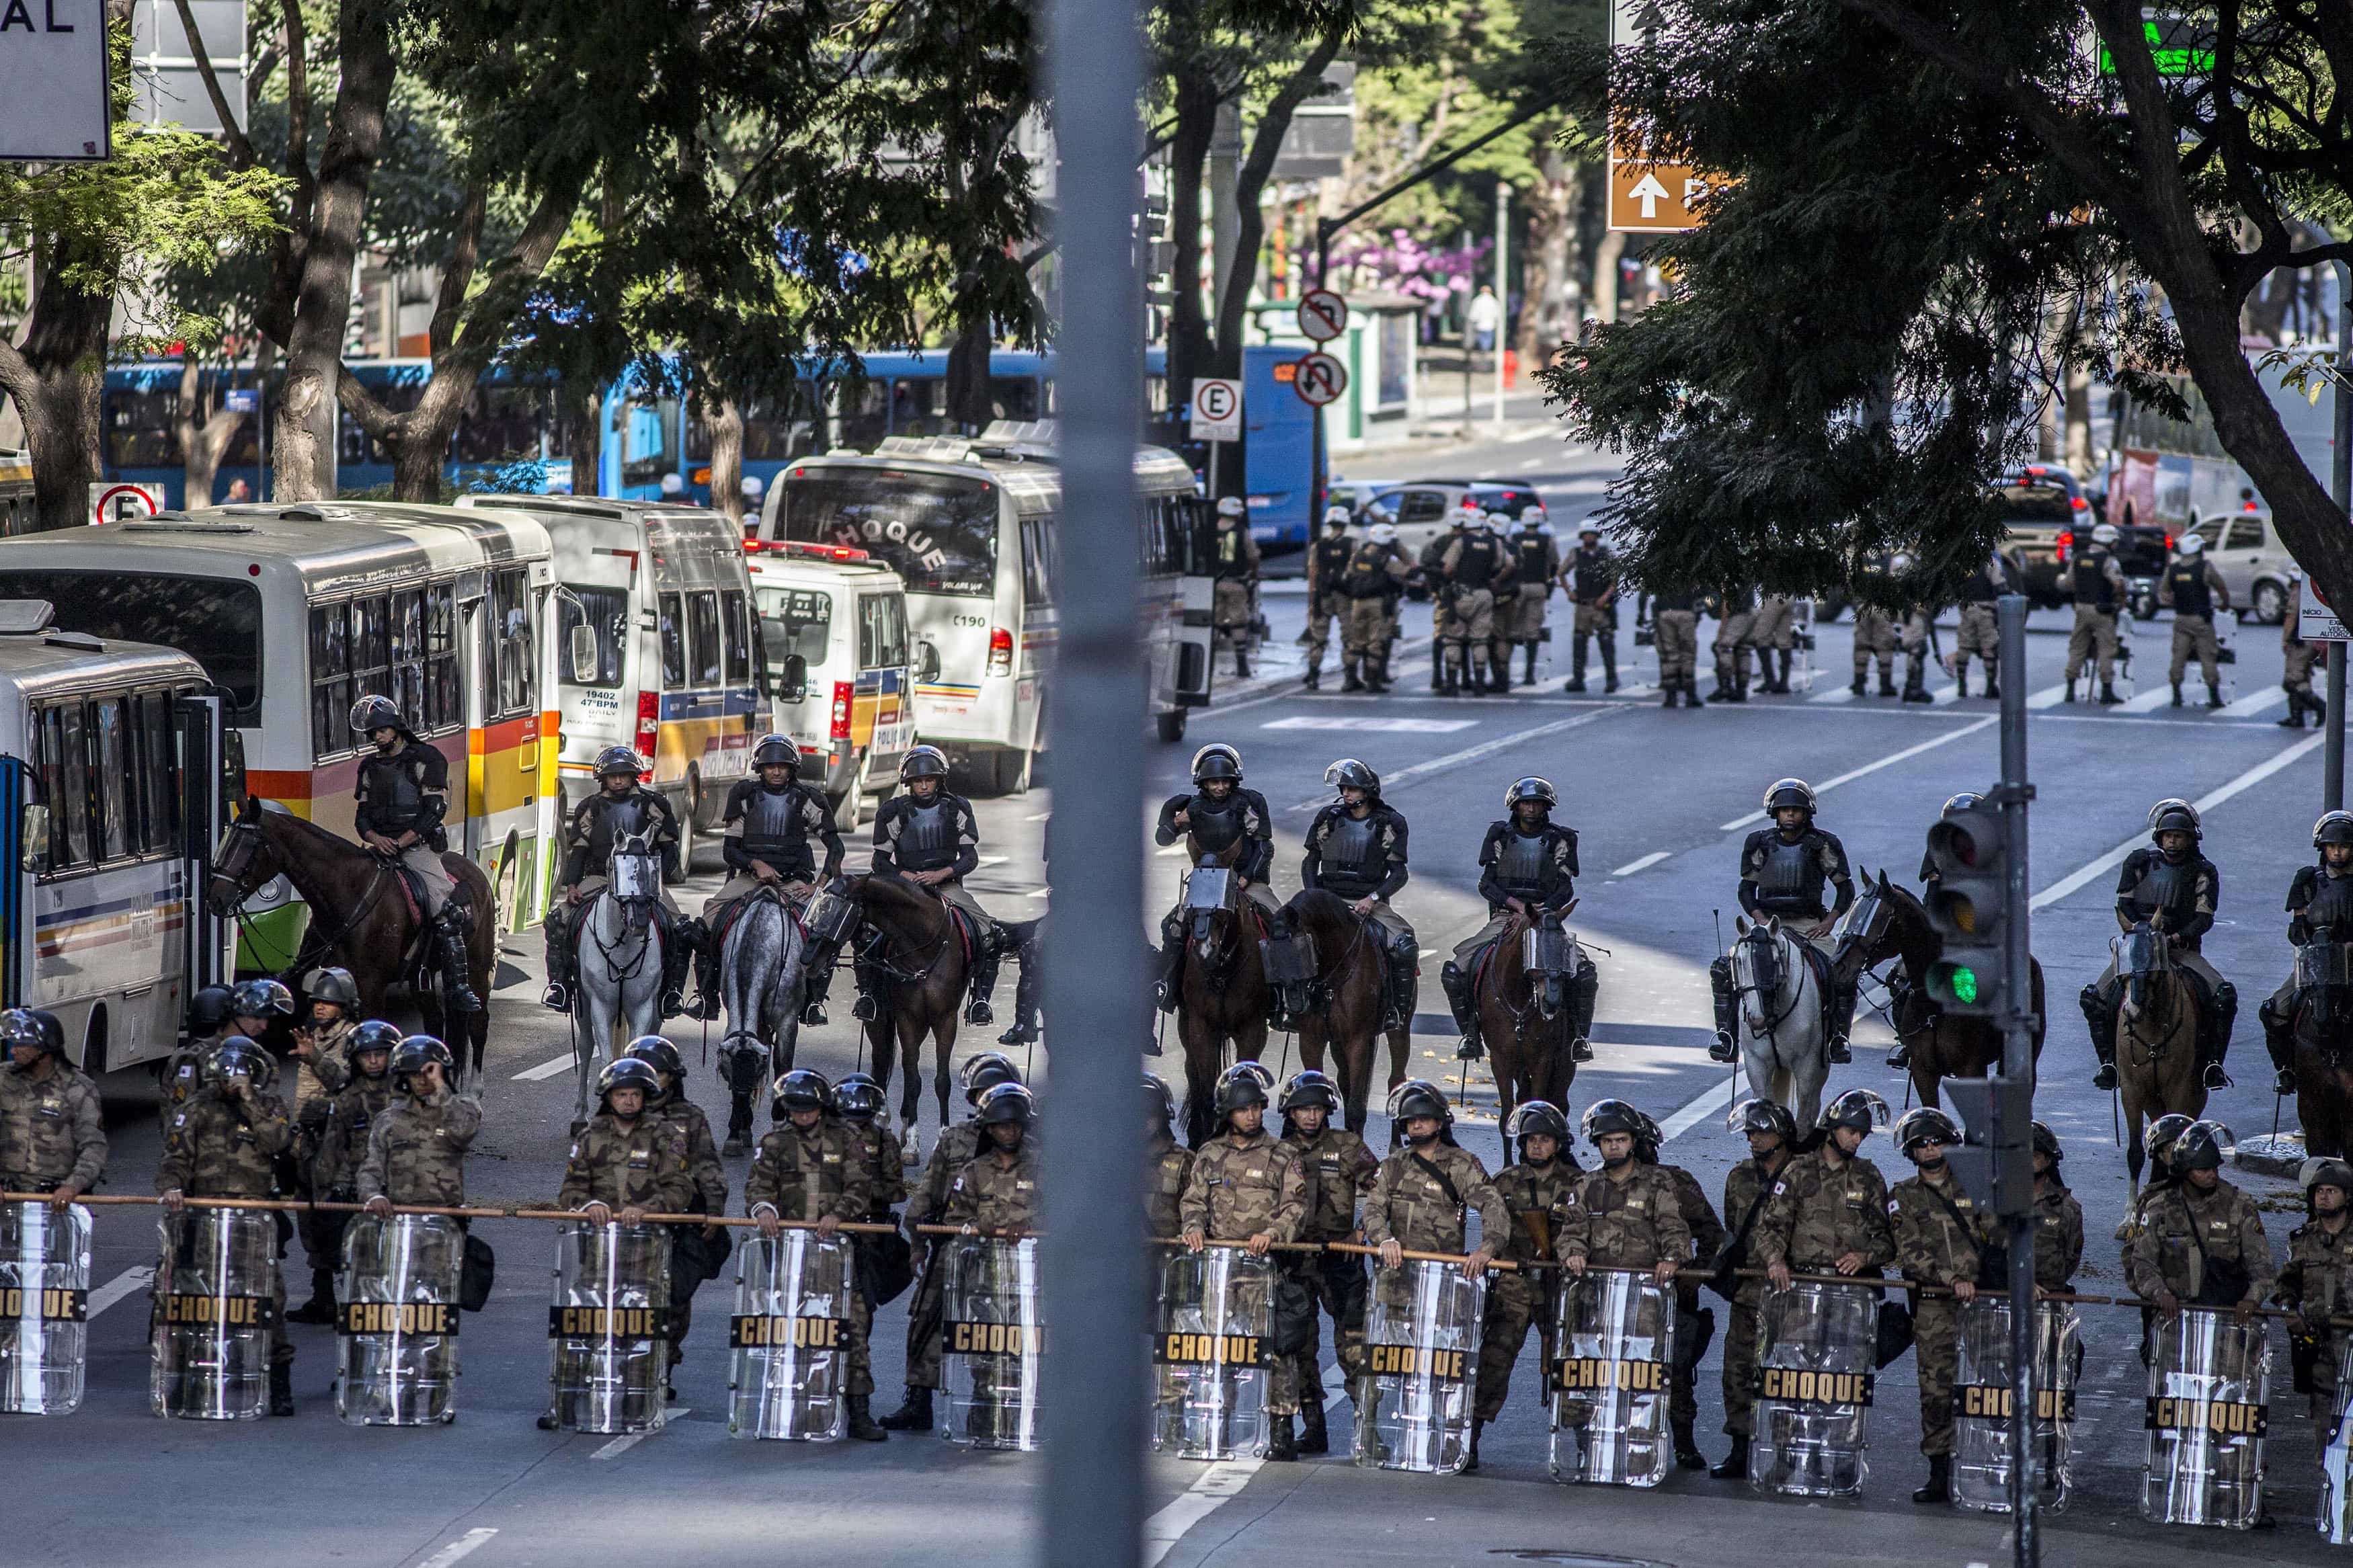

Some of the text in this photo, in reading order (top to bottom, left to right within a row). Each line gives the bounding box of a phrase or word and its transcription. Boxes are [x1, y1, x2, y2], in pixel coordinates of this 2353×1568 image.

[1209, 388, 1224, 413] E
[836, 520, 947, 572] HOQUE
[953, 615, 986, 628] C190
[2302, 608, 2322, 616] INÍCIO
[586, 690, 616, 700] 19402
[0, 1289, 74, 1318] OQUE
[167, 1296, 258, 1323] CHOQUE
[350, 1304, 447, 1335] CHOQUE
[563, 1308, 655, 1337] CHOQUE
[741, 1317, 839, 1349] CHOQUE
[955, 1323, 1042, 1356] CHOQU
[1167, 1334, 1259, 1365] CHOQUE
[1372, 1346, 1463, 1378] CHOQUE
[1563, 1360, 1663, 1392] CHOQUE
[1765, 1369, 1865, 1404] CHOQUE
[1966, 1387, 2066, 1419] CHOUE
[2157, 1398, 2259, 1434] CHOQUE
